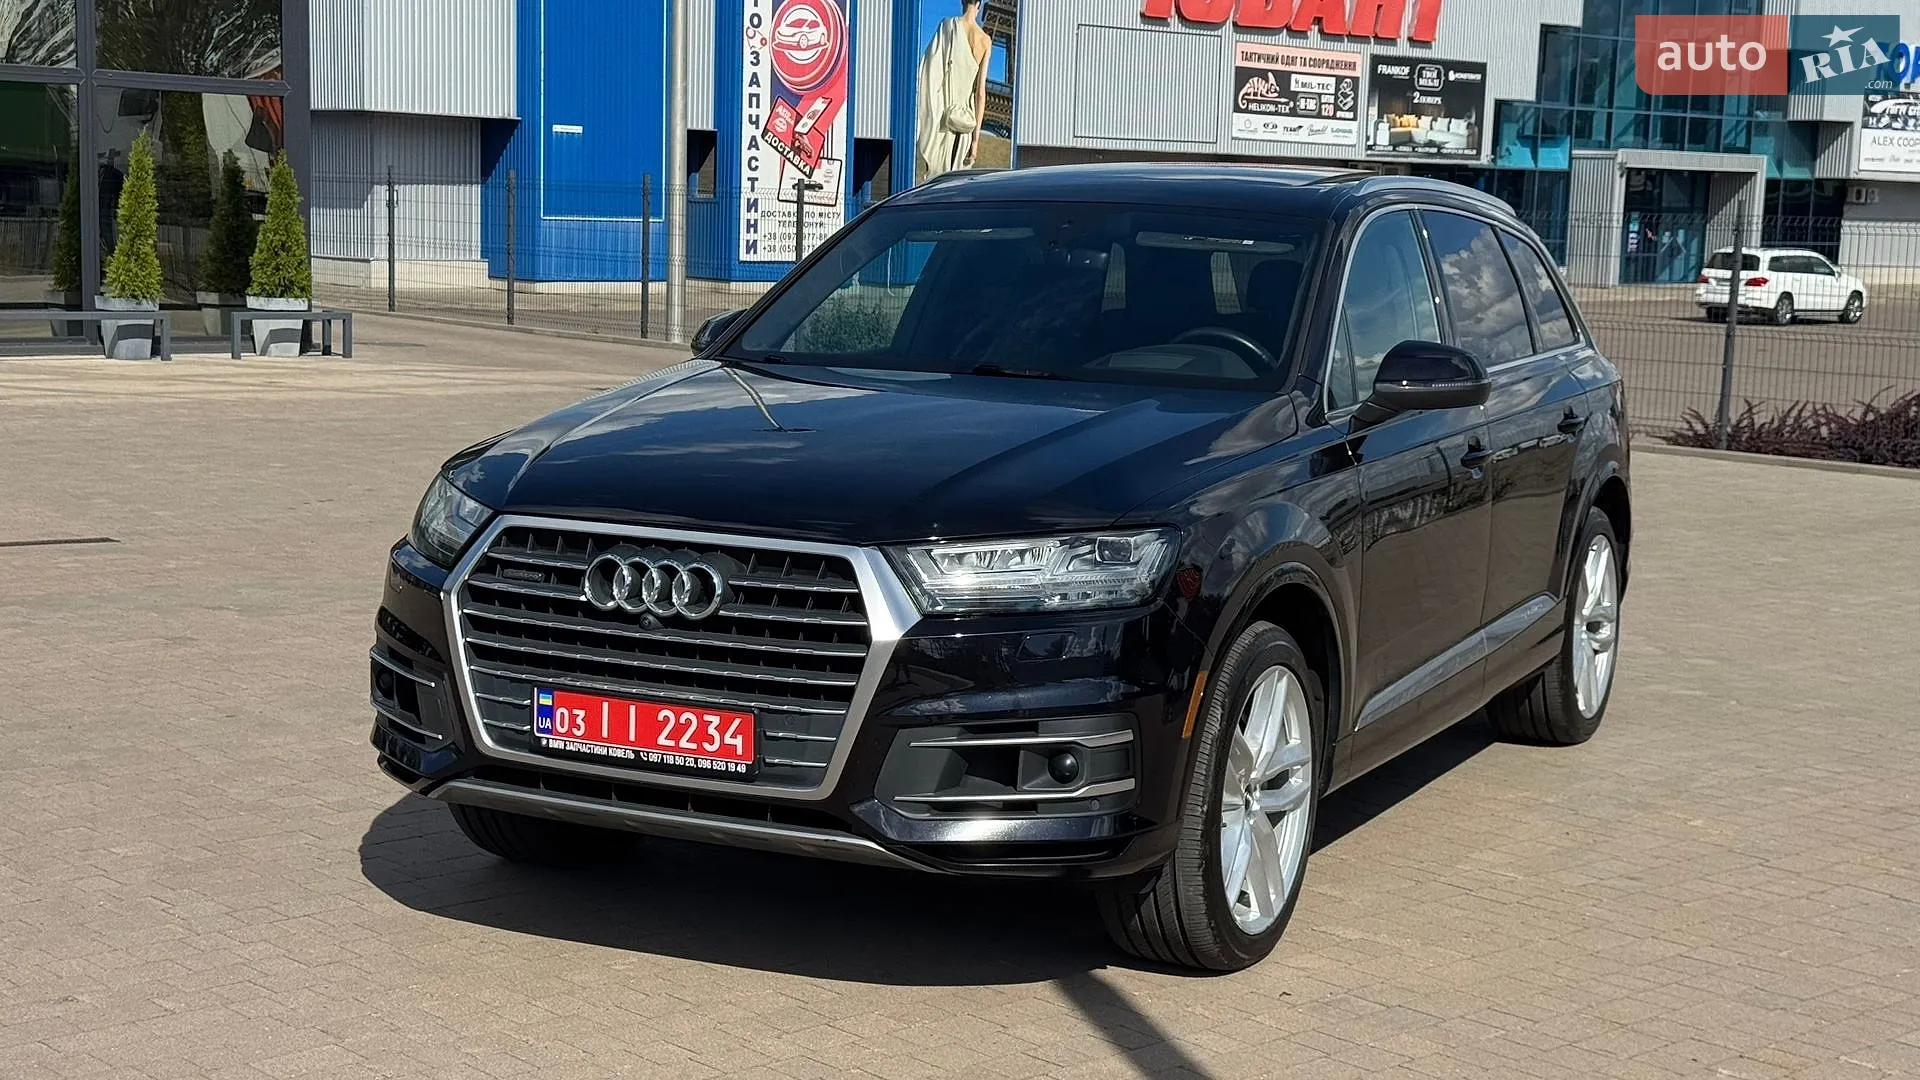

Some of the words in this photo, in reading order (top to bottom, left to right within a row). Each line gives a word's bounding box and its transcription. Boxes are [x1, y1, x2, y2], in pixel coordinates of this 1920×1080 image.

[1377, 64, 1410, 76] FRANKOF
[745, 50, 761, 255] ЗАПЧАСТИНИ
[763, 131, 811, 175] ДОСТАВКА
[1871, 136, 1894, 146] ALEX
[760, 210, 798, 218] ДОСТАВК
[804, 211, 816, 219] ПО
[818, 211, 841, 219] МІСТУ
[538, 716, 553, 730] UA
[555, 707, 587, 737] 03
[656, 709, 744, 756] 2234
[548, 738, 565, 750] BMW
[565, 741, 608, 756] ЗАПЧАСТИНИ
[608, 747, 636, 759] КОВЕЛЬ
[648, 752, 662, 763] 097
[662, 754, 674, 764] 118
[675, 755, 685, 766] 50
[697, 759, 712, 769] 096
[712, 761, 727, 771] 520
[727, 762, 736, 772] 19
[736, 763, 747, 774] 49
